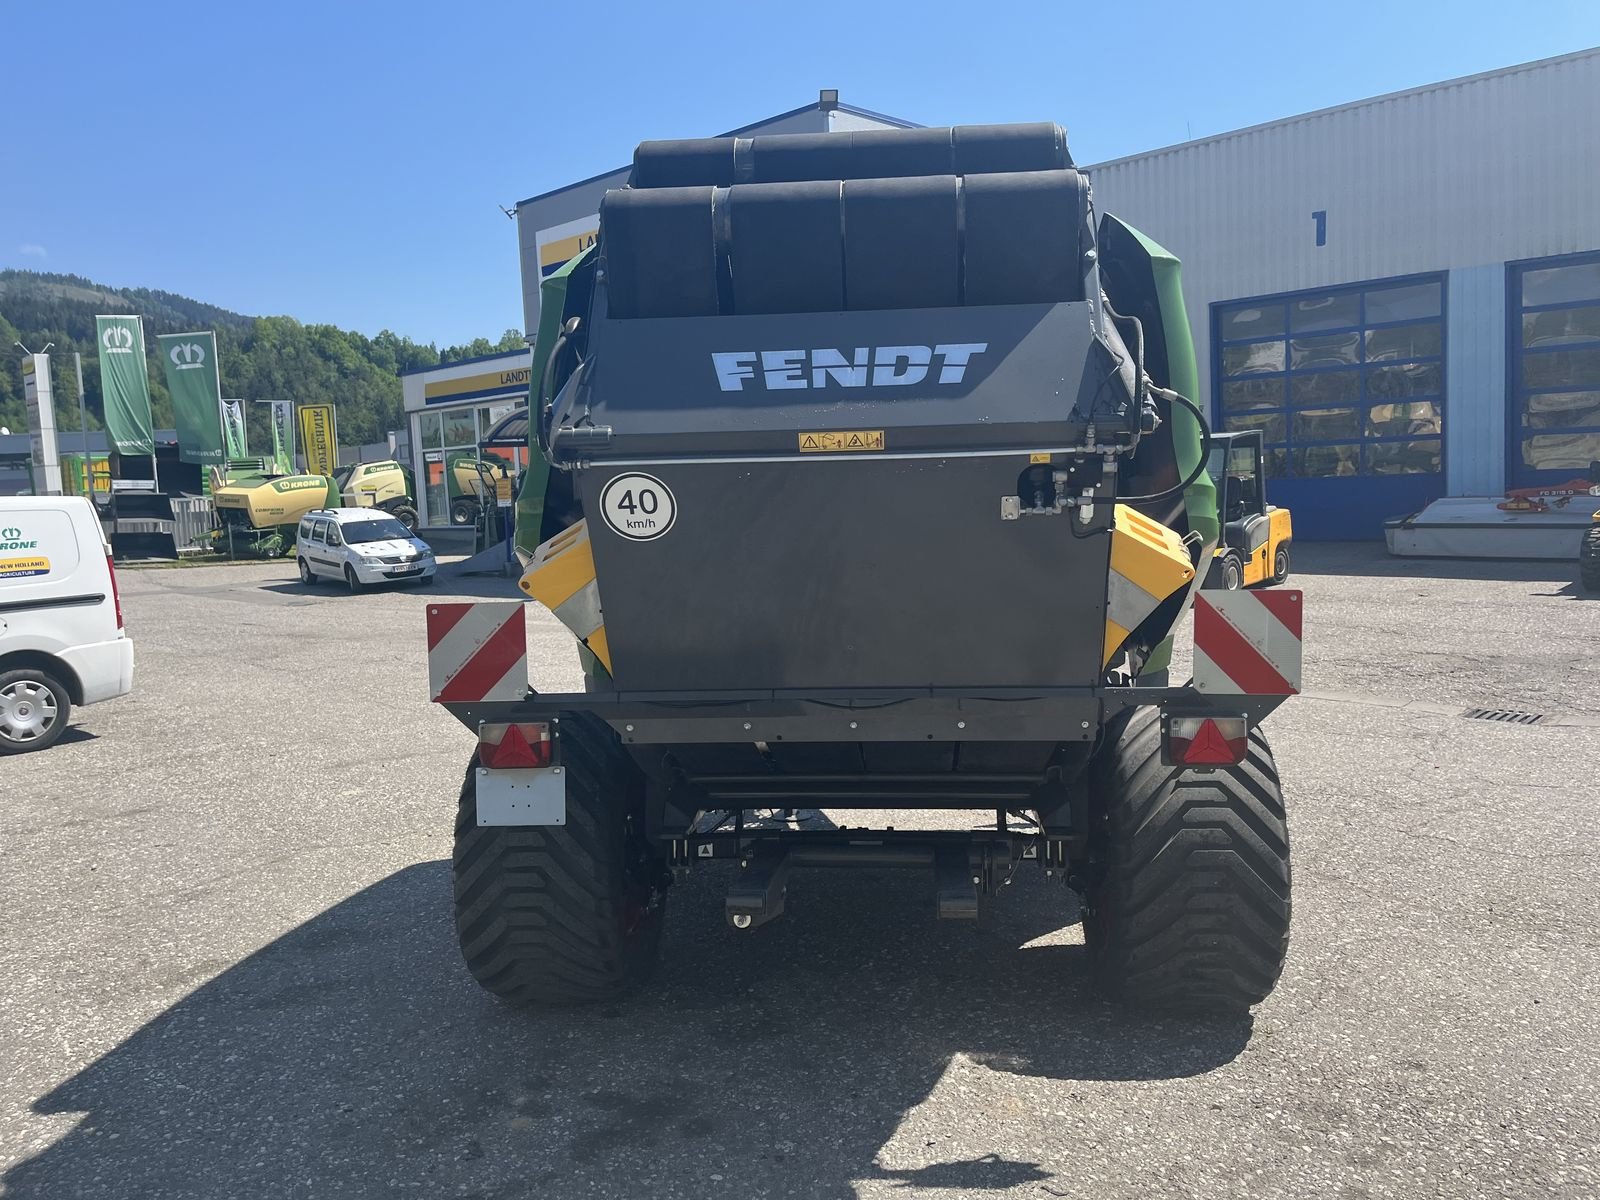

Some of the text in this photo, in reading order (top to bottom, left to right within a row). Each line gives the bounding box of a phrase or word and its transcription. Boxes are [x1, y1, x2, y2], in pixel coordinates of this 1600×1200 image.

[1312, 210, 1327, 247] 1
[578, 233, 598, 253] LA
[711, 342, 989, 392] FENDT
[500, 369, 531, 385] LANDT
[291, 480, 321, 489] KRONE
[617, 488, 659, 515] 40
[626, 519, 656, 529] km/h
[0, 540, 38, 550] RONE
